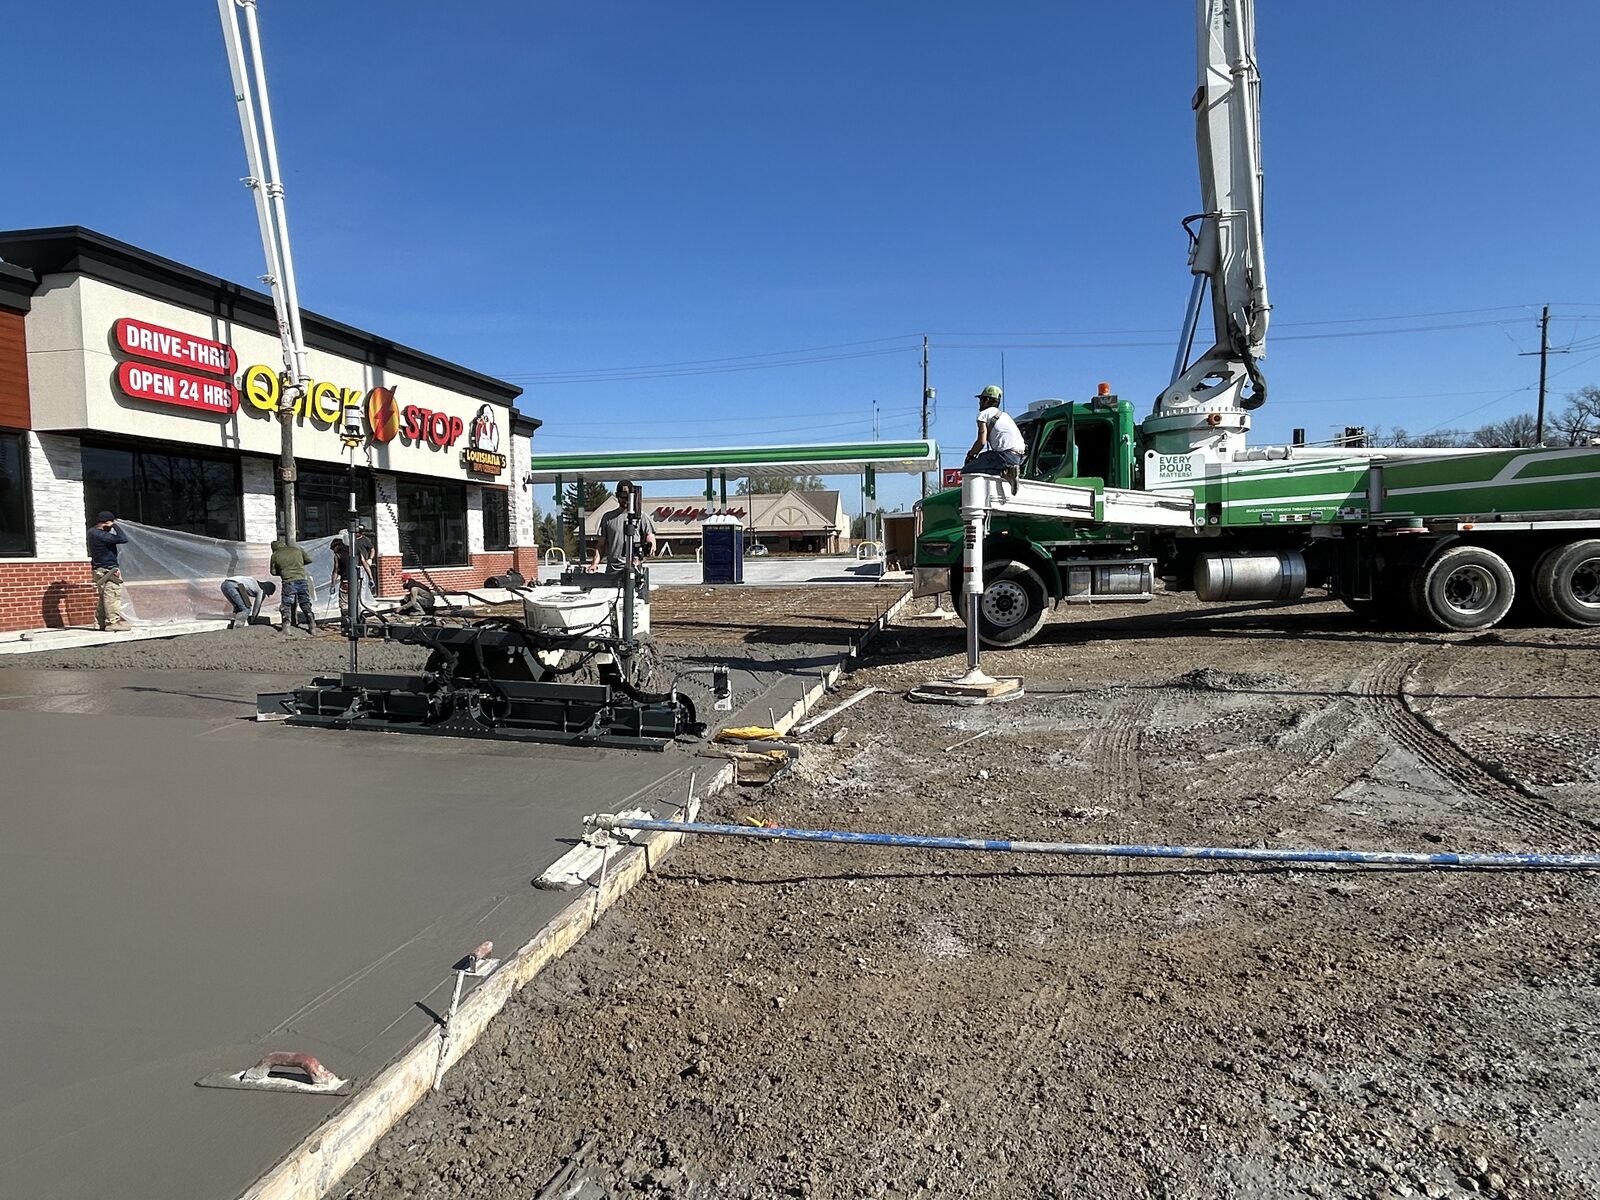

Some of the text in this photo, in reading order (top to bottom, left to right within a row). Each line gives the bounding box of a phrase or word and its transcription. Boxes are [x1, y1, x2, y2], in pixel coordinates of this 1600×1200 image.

[126, 324, 231, 369] DRIVE-THRU
[129, 368, 232, 407] OPEN 24 HRS
[245, 364, 463, 447] QICK STOP
[466, 449, 506, 467] LOUISIANA'S
[1159, 456, 1191, 464] EVERY
[1159, 464, 1192, 472] POUR
